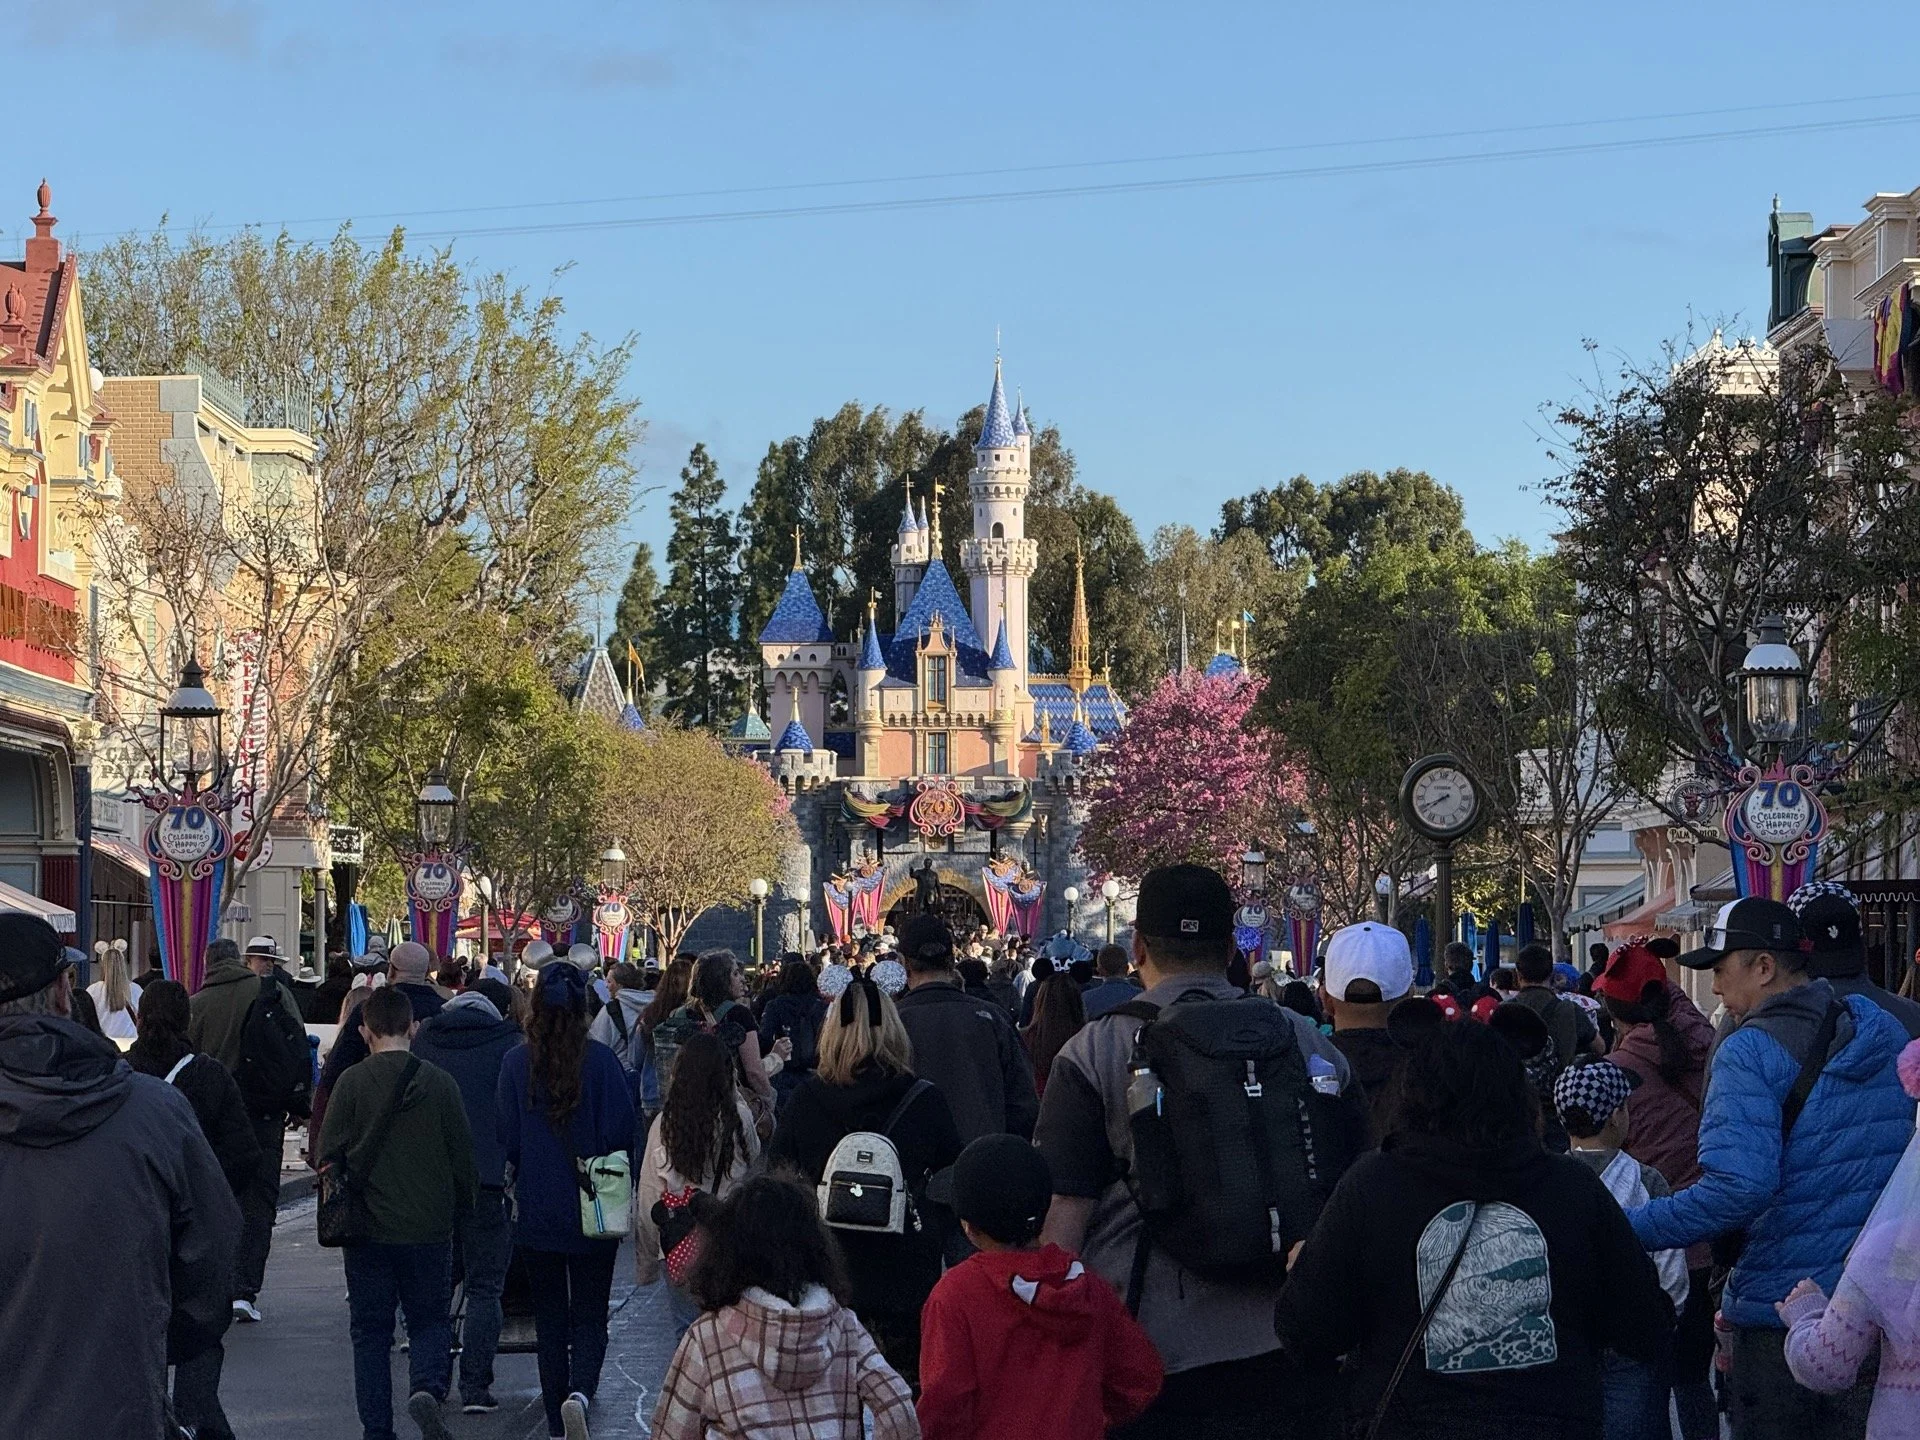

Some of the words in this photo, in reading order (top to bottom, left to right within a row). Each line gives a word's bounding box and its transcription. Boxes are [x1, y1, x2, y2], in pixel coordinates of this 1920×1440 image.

[1758, 780, 1801, 808] 70
[920, 799, 946, 816] 70
[168, 805, 206, 830] 70
[1669, 829, 1691, 840] PALM
[421, 863, 447, 879] 70
[605, 902, 622, 913] 70
[1247, 904, 1263, 914] 70
[1297, 1097, 1317, 1179] OAKLEY
